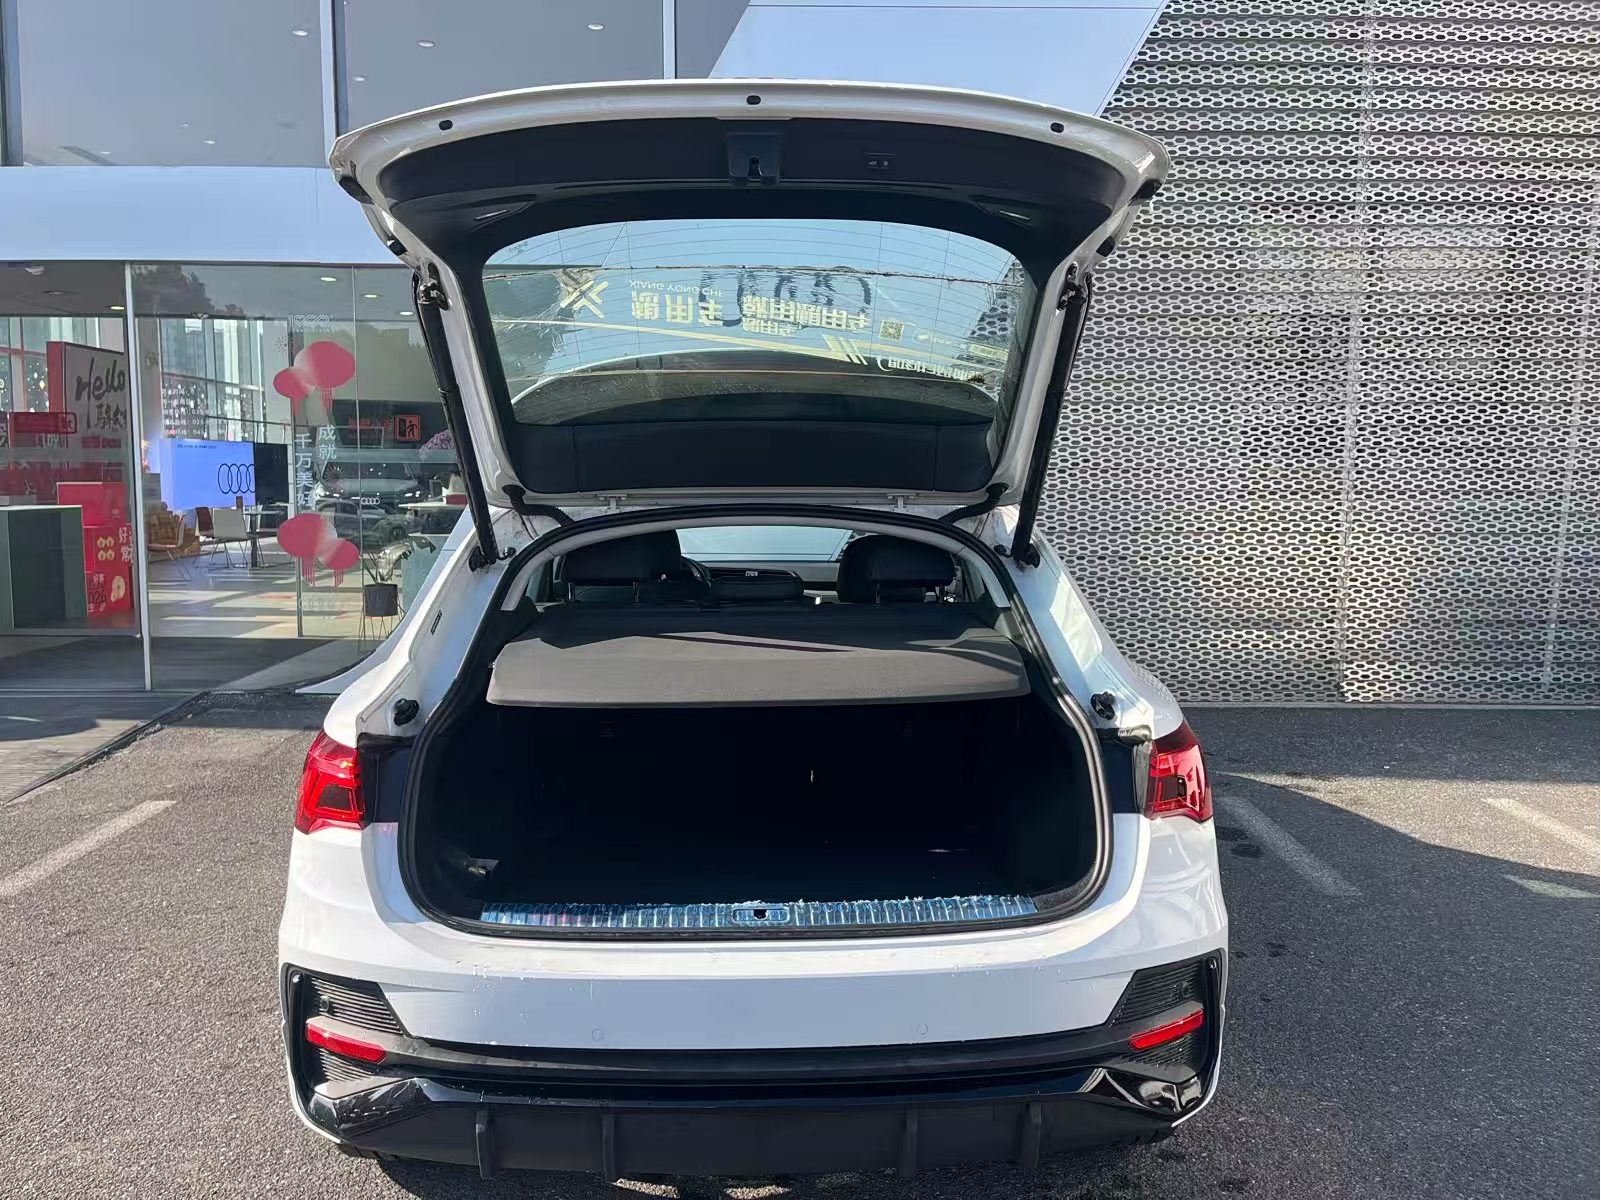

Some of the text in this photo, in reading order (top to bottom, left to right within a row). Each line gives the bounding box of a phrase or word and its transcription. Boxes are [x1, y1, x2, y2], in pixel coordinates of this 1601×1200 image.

[294, 432, 316, 508] 千万美好
[318, 424, 337, 460] 成就
